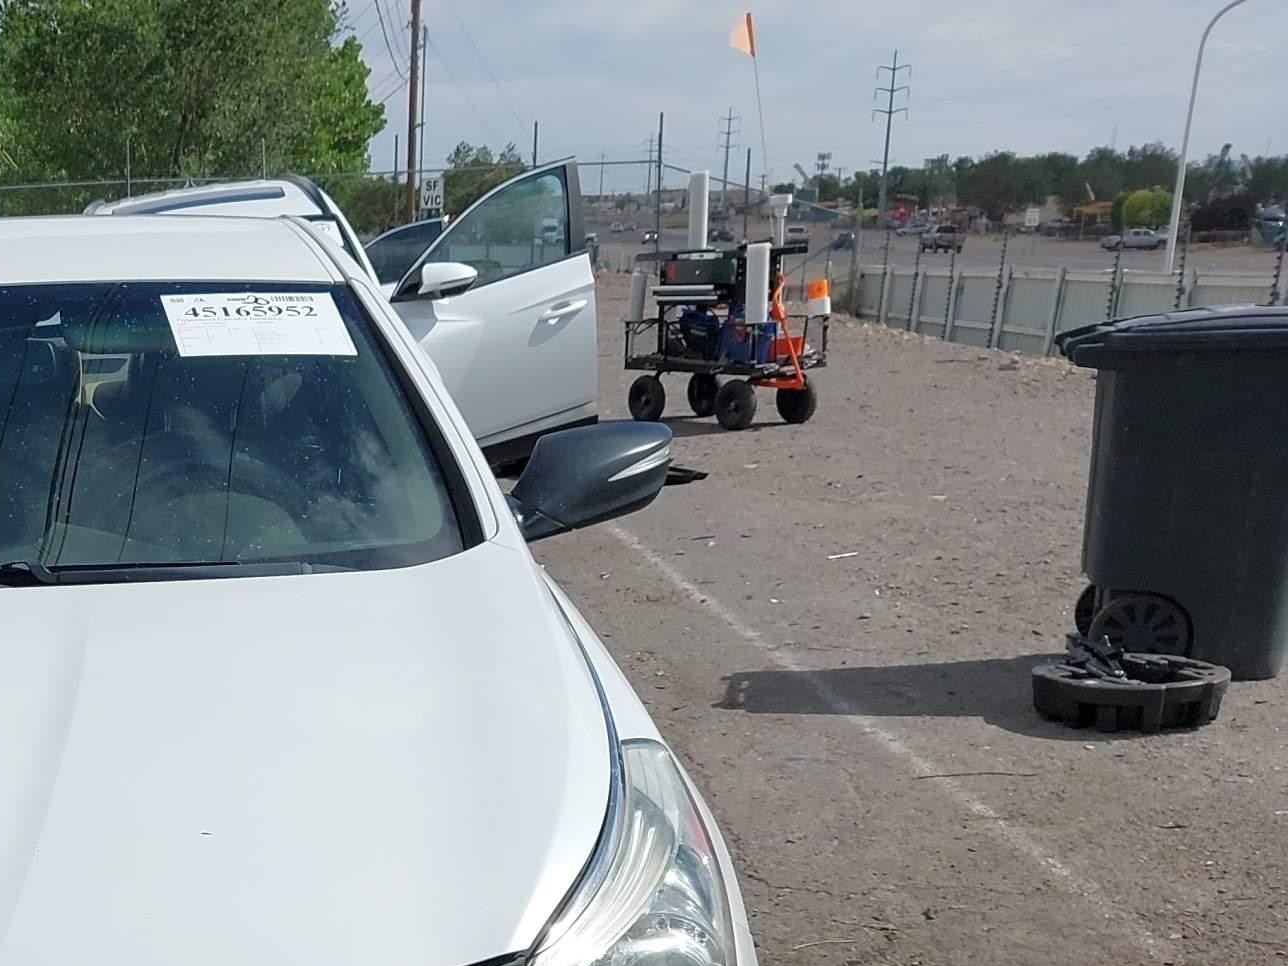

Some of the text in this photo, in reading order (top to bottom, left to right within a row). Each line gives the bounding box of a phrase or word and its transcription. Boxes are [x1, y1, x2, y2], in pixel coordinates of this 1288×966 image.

[426, 180, 439, 192] SF
[423, 195, 441, 206] VIC
[184, 305, 317, 317] 45165952
